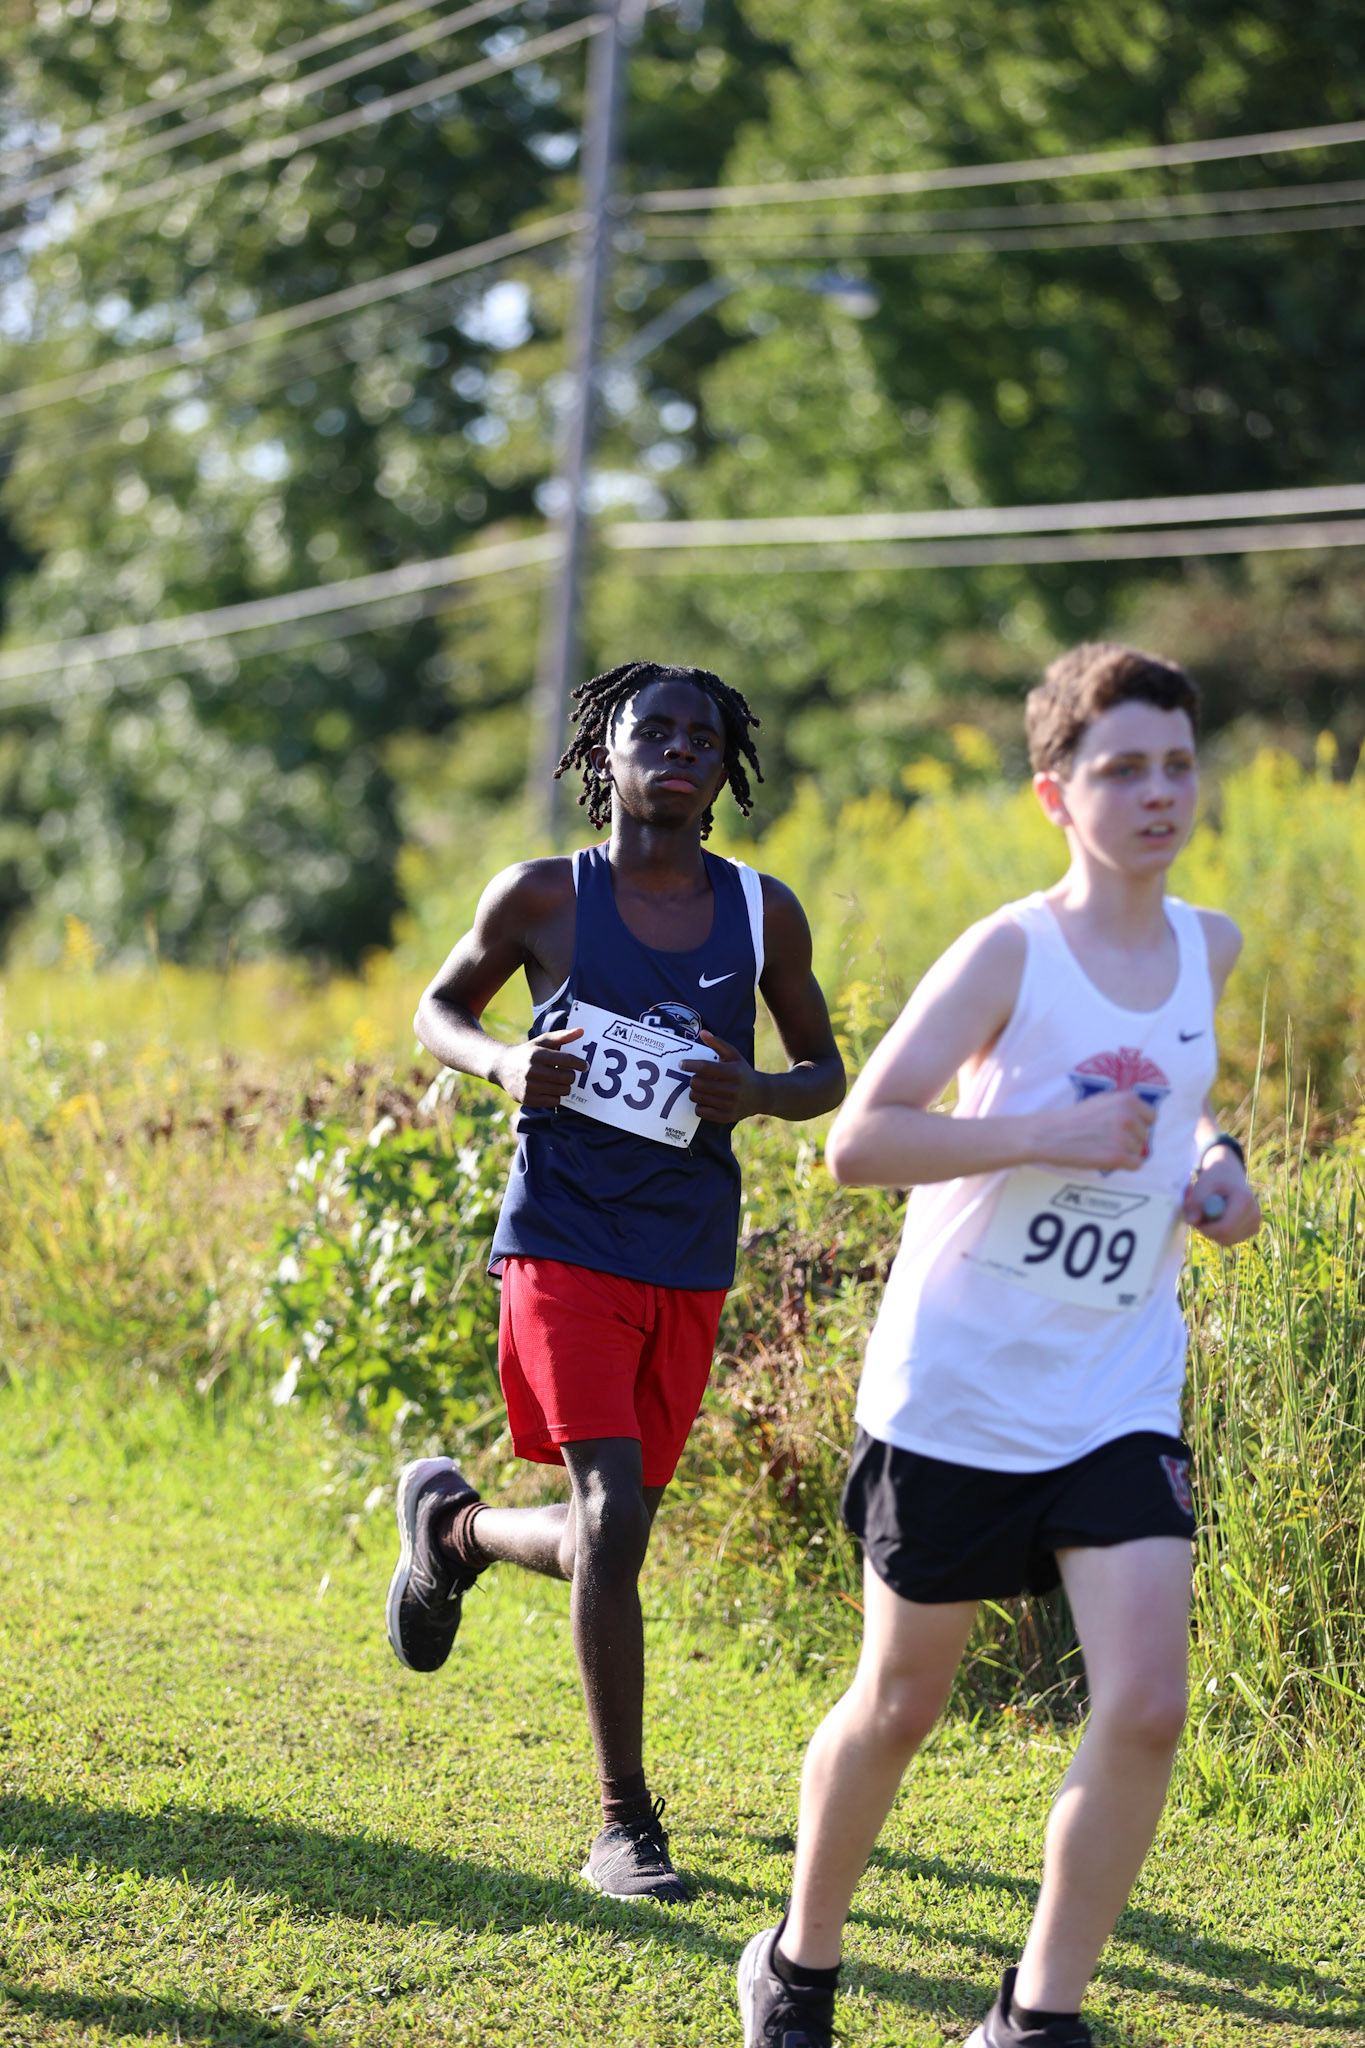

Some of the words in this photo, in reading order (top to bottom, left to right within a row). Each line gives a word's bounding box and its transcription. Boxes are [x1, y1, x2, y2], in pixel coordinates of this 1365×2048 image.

[633, 1033, 665, 1048] MEMPHIS
[577, 1040, 694, 1120] 1337
[1023, 1212, 1137, 1284] 909
